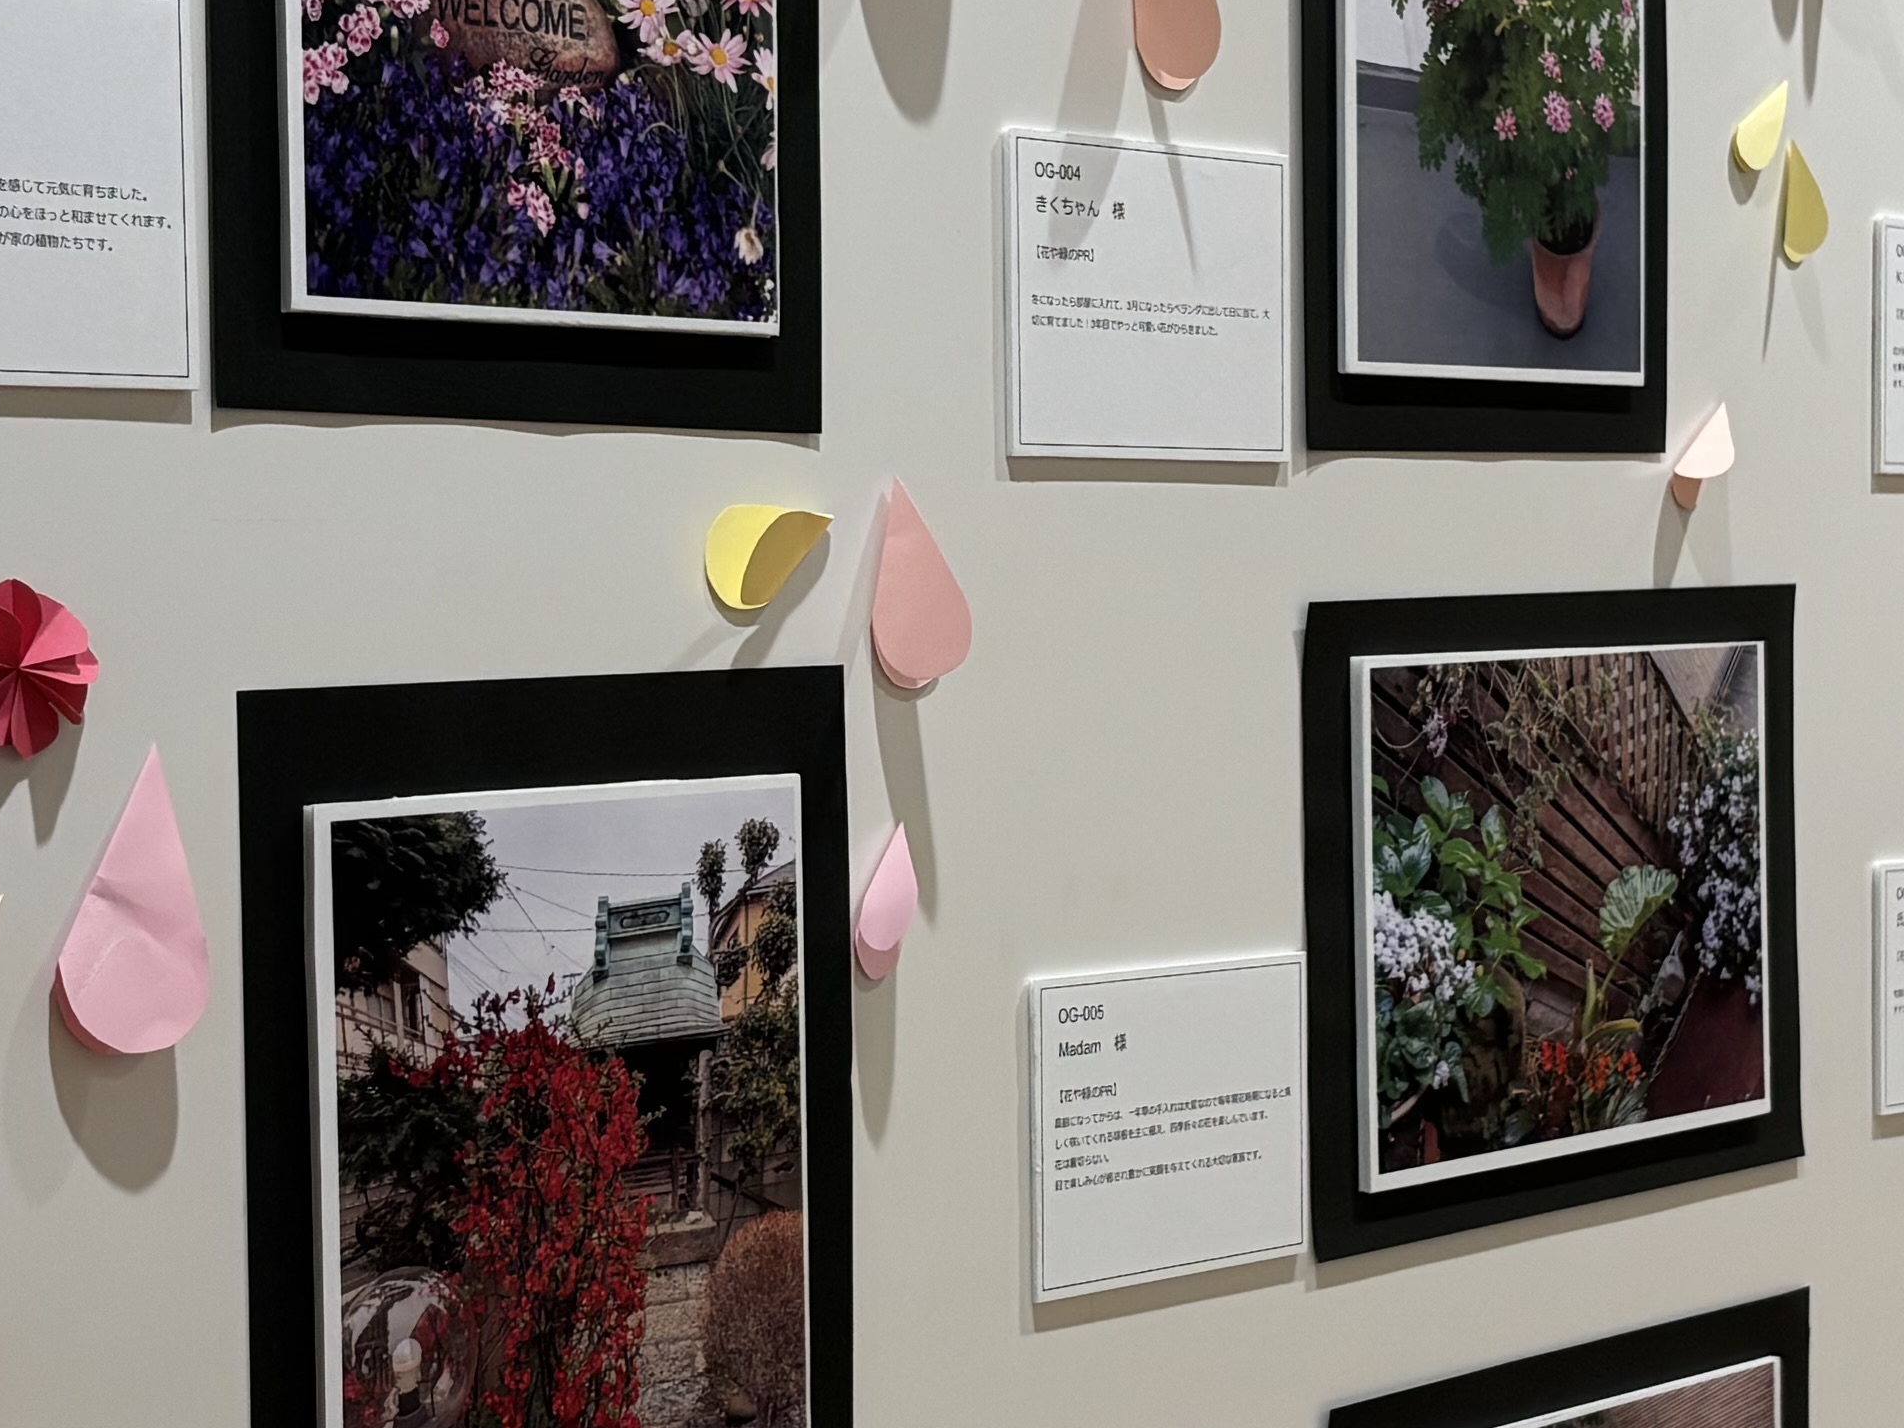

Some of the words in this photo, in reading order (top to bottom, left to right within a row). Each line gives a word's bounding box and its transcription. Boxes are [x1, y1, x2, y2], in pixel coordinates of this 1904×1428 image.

[1034, 161, 1081, 182] OG-004
[1035, 195, 1100, 219] きくちゃん
[1112, 200, 1126, 221] 様
[1058, 1004, 1105, 1024] OG-005
[1058, 1039, 1102, 1058] Madam
